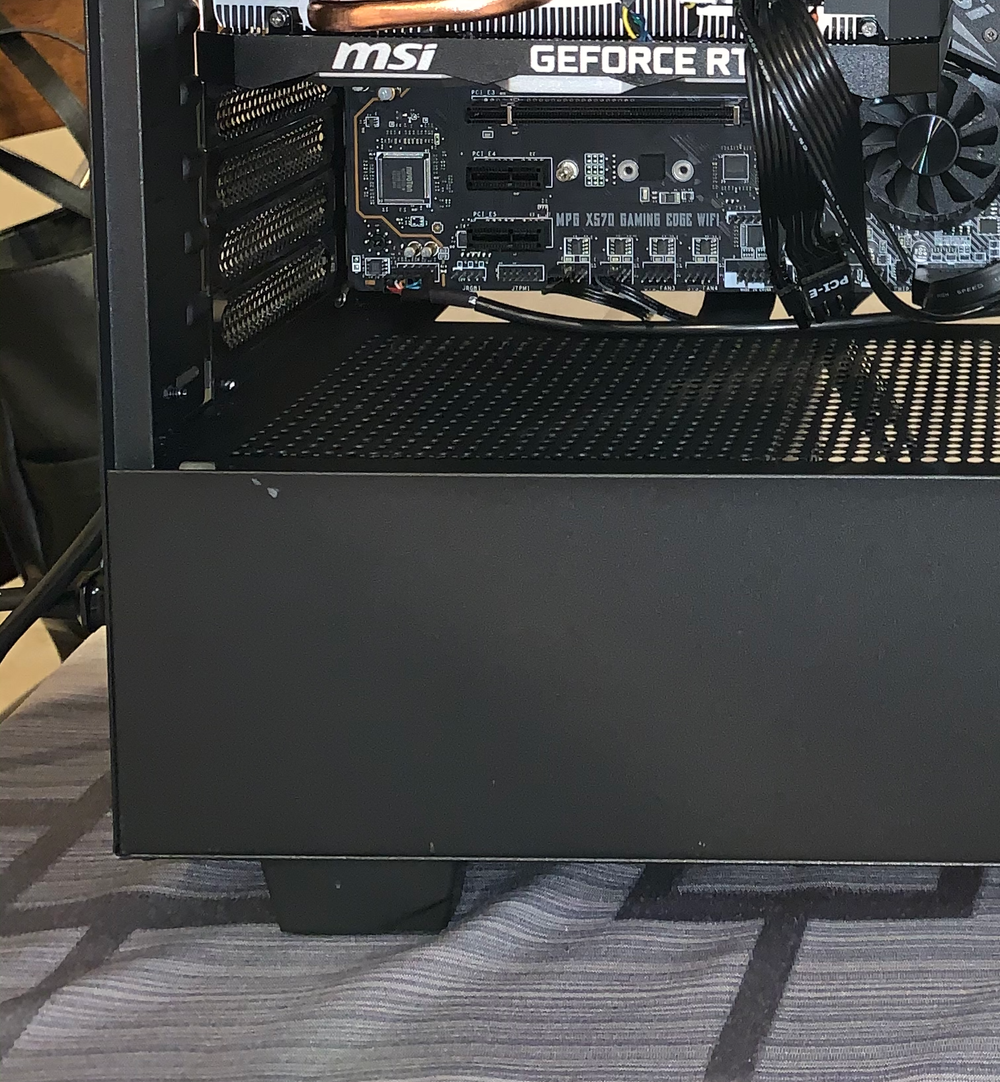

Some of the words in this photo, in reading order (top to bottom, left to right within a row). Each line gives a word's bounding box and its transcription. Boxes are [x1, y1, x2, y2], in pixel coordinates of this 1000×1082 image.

[331, 41, 438, 72] msi
[530, 44, 696, 76] GEFORCE
[556, 212, 580, 227] MPG
[585, 212, 615, 227] X570
[620, 212, 660, 227] GAMING
[665, 212, 693, 227] EDGE
[697, 212, 720, 227] WIFI
[808, 274, 849, 299] PCI-E
[956, 283, 984, 296] SPEED
